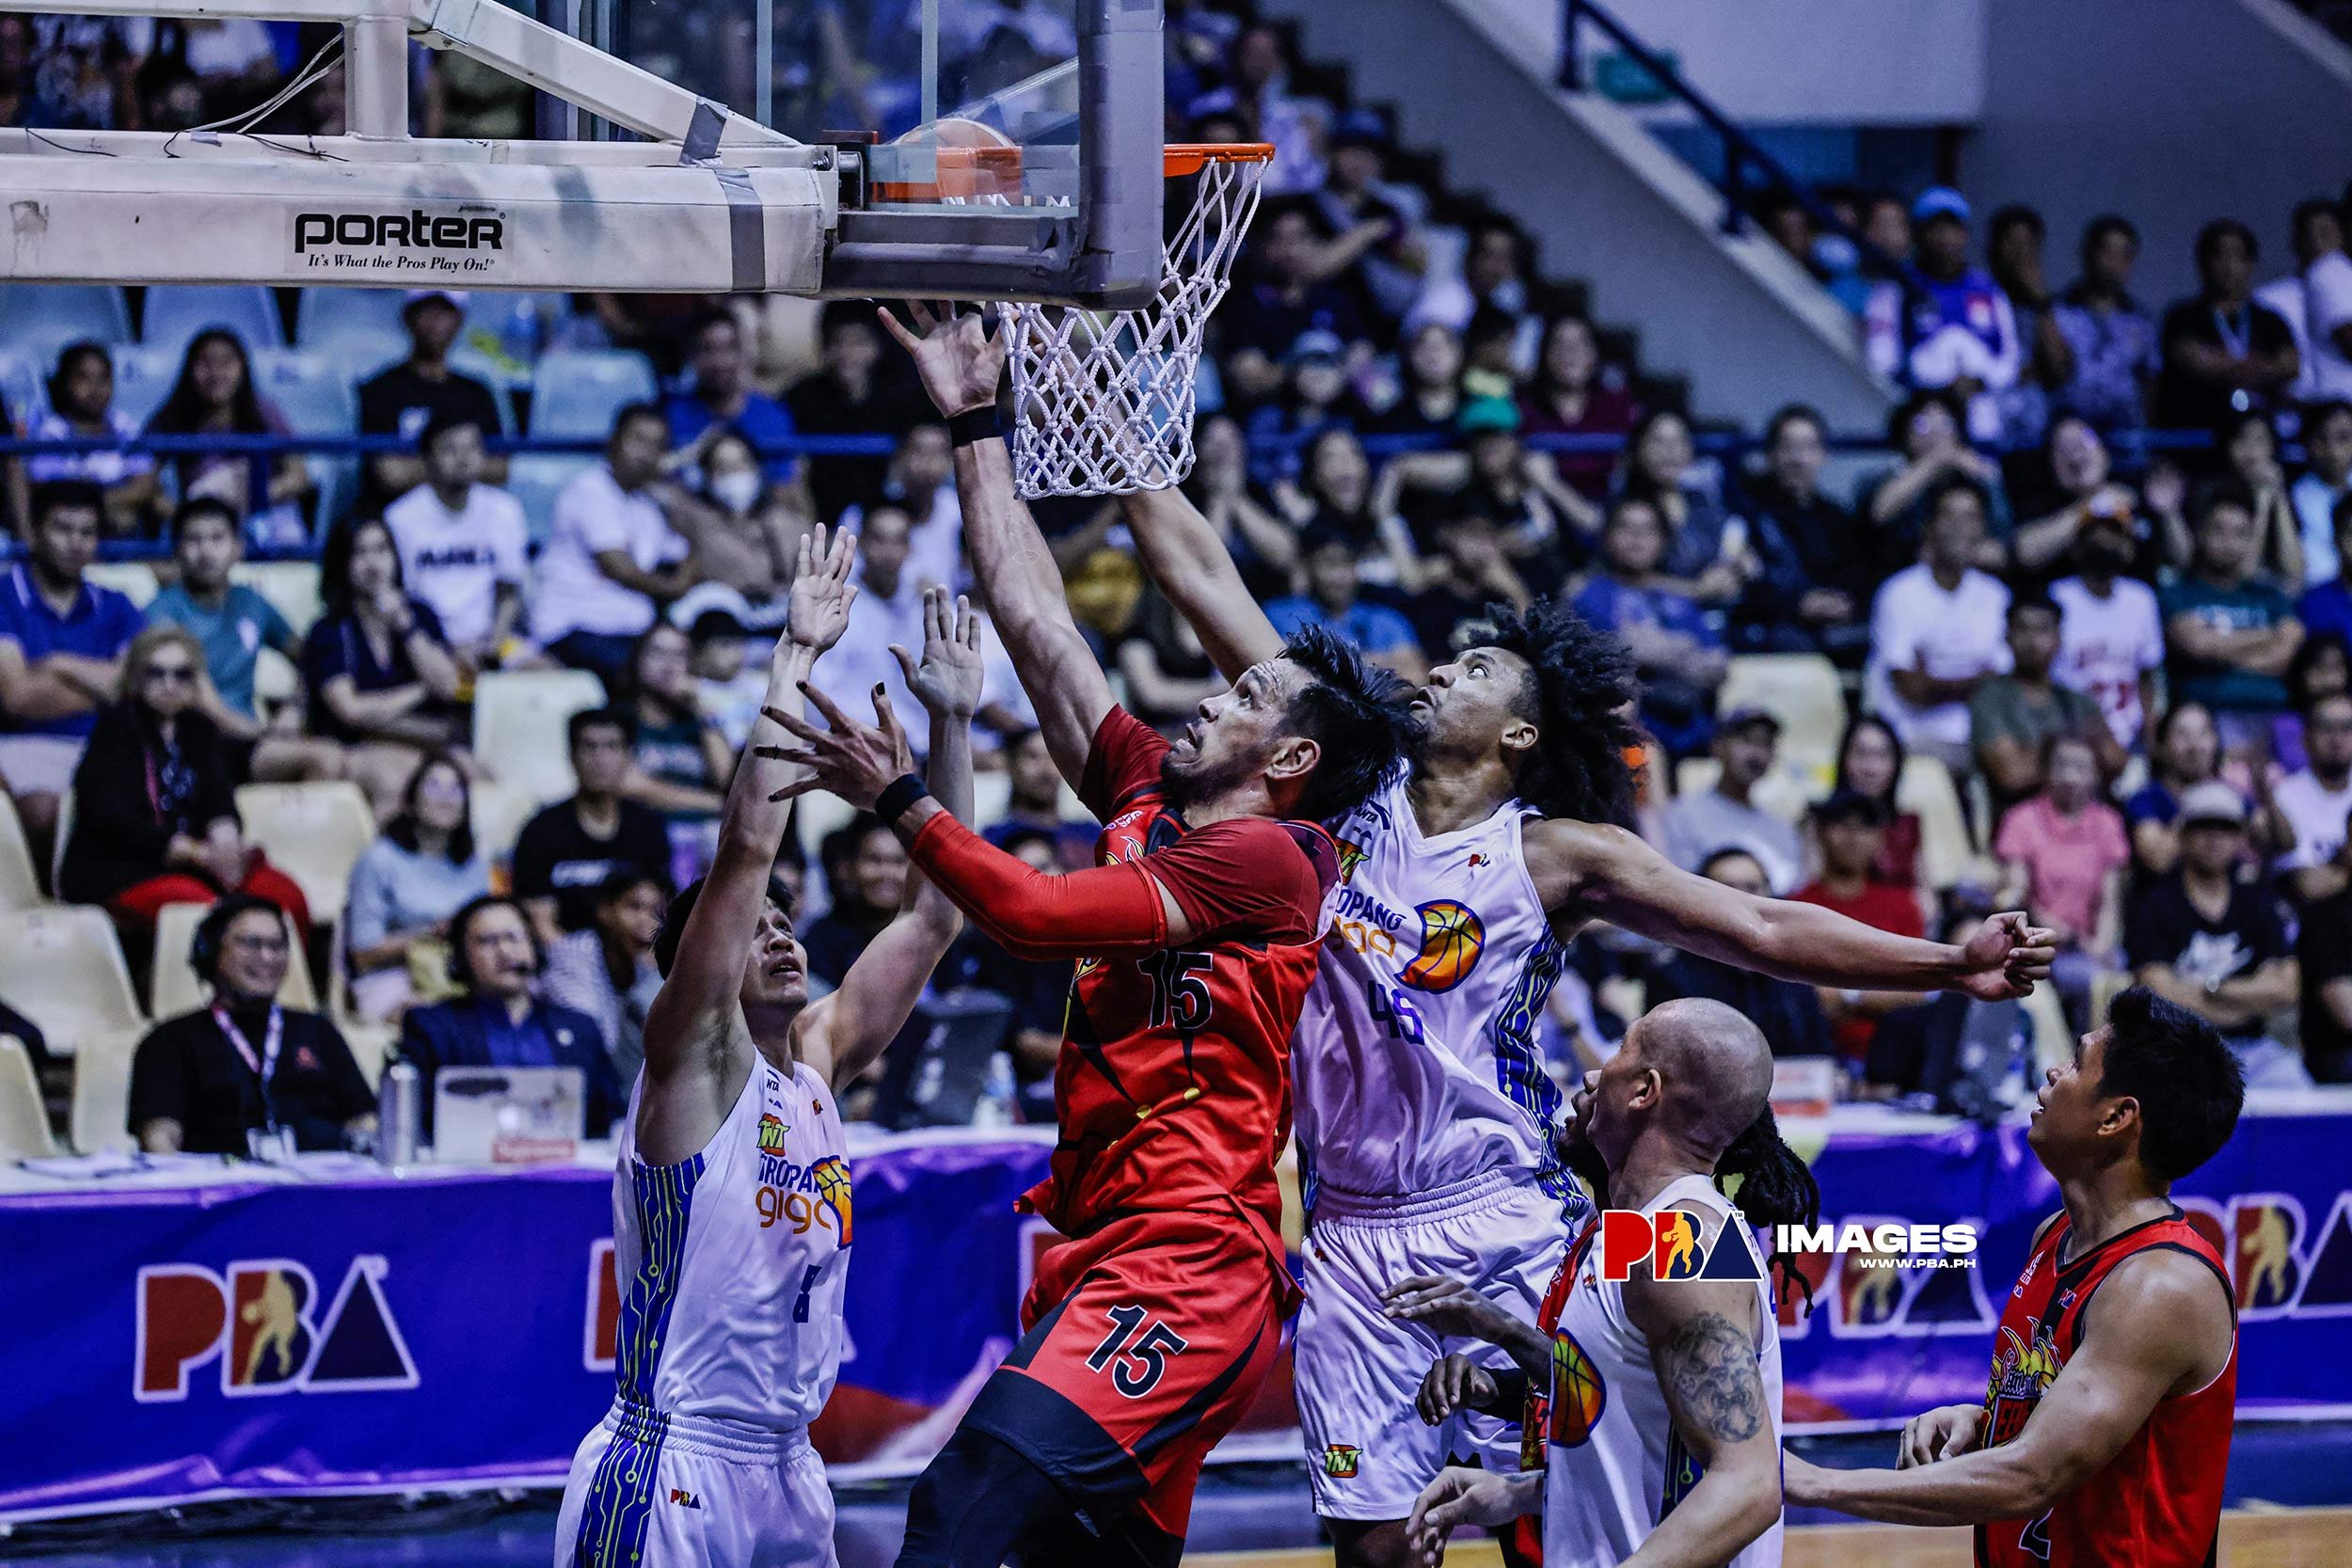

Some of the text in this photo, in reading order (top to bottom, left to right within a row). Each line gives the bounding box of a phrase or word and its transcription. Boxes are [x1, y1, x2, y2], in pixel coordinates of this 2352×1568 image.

[308, 254, 489, 274] It's What the Pros Play On!
[1336, 888, 1406, 931] OPANG
[1136, 949, 1214, 1030] 15
[756, 1119, 791, 1148] TNT
[2169, 1190, 2352, 1323] BA
[134, 1256, 421, 1402] PBA
[1084, 1304, 1189, 1400] 15
[1325, 1449, 1364, 1473] TNT
[670, 1488, 702, 1510] PBA
